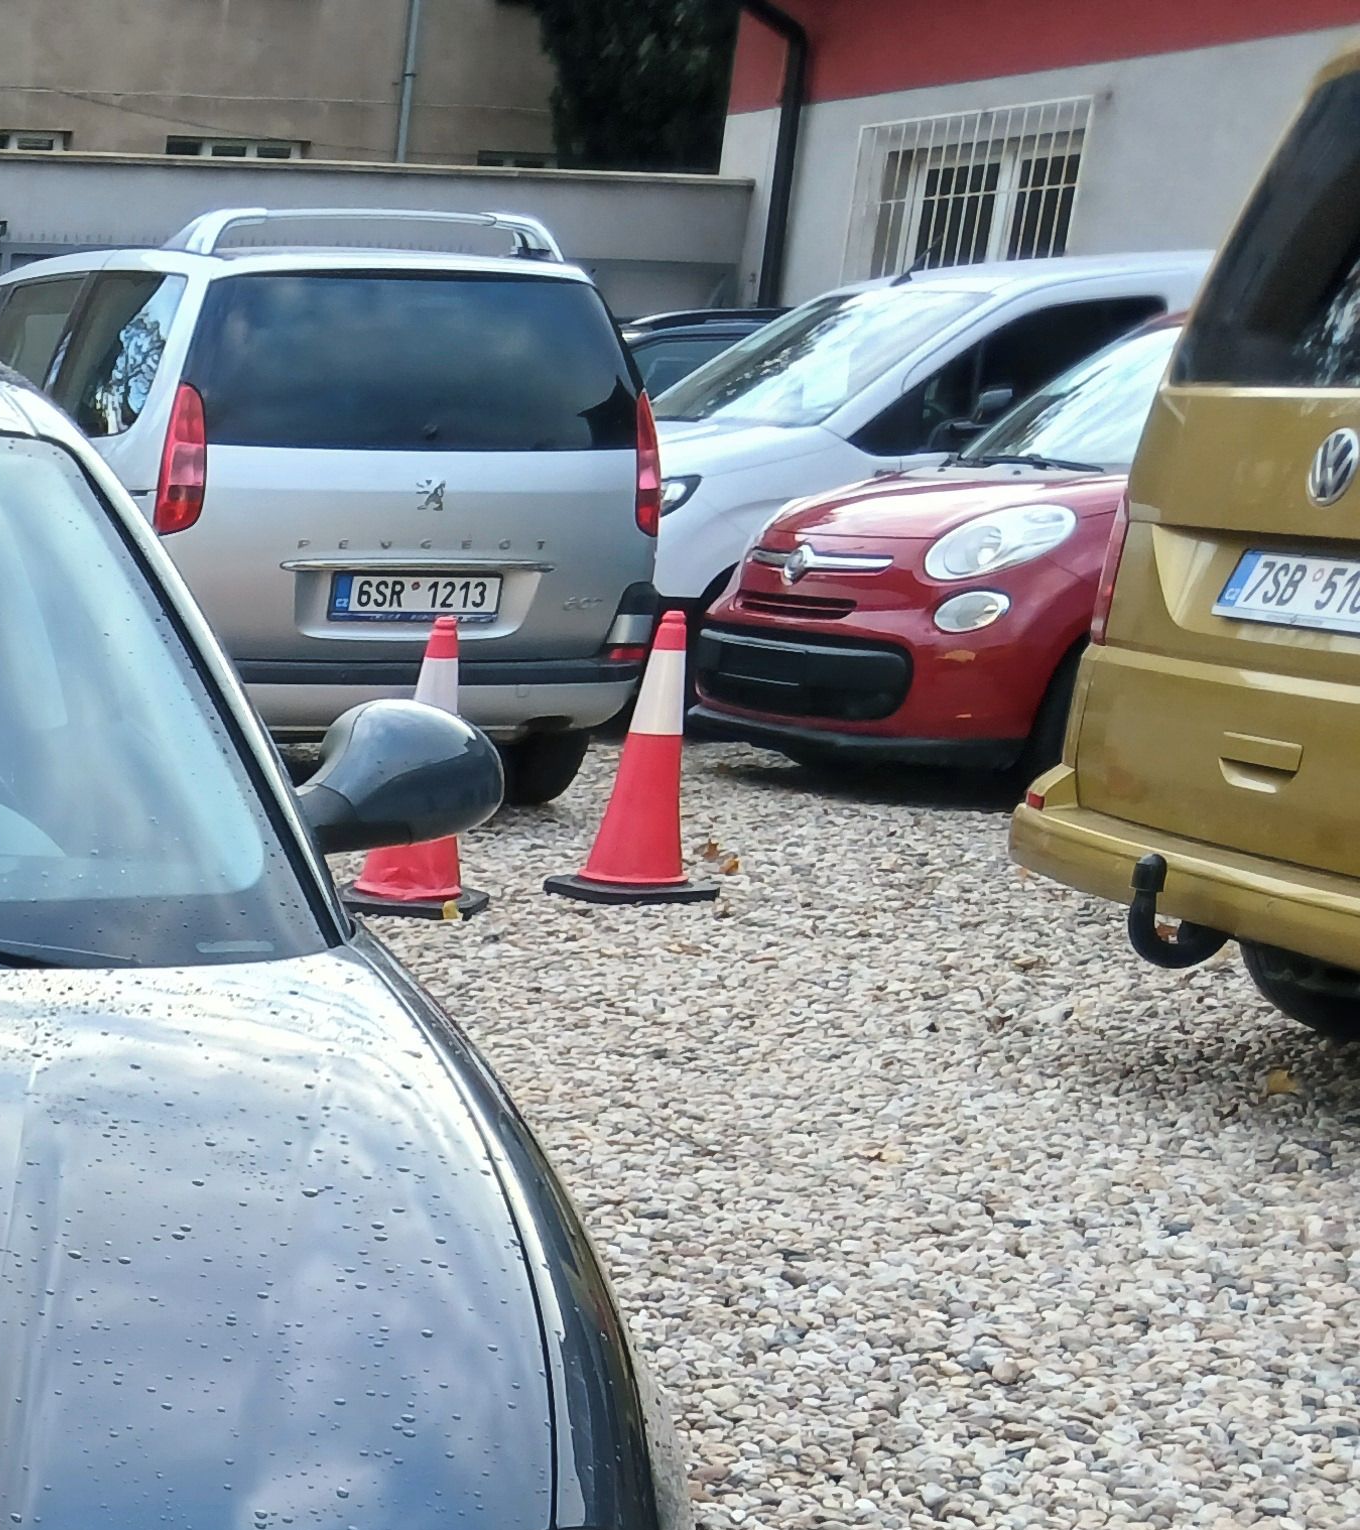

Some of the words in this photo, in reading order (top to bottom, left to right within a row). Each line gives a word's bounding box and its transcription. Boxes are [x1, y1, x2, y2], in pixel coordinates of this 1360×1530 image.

[297, 540, 548, 551] PEUGEOT
[335, 598, 349, 608] CZ
[356, 580, 405, 608] 6SR
[427, 581, 488, 609] 1213
[1242, 561, 1308, 606] 7SB
